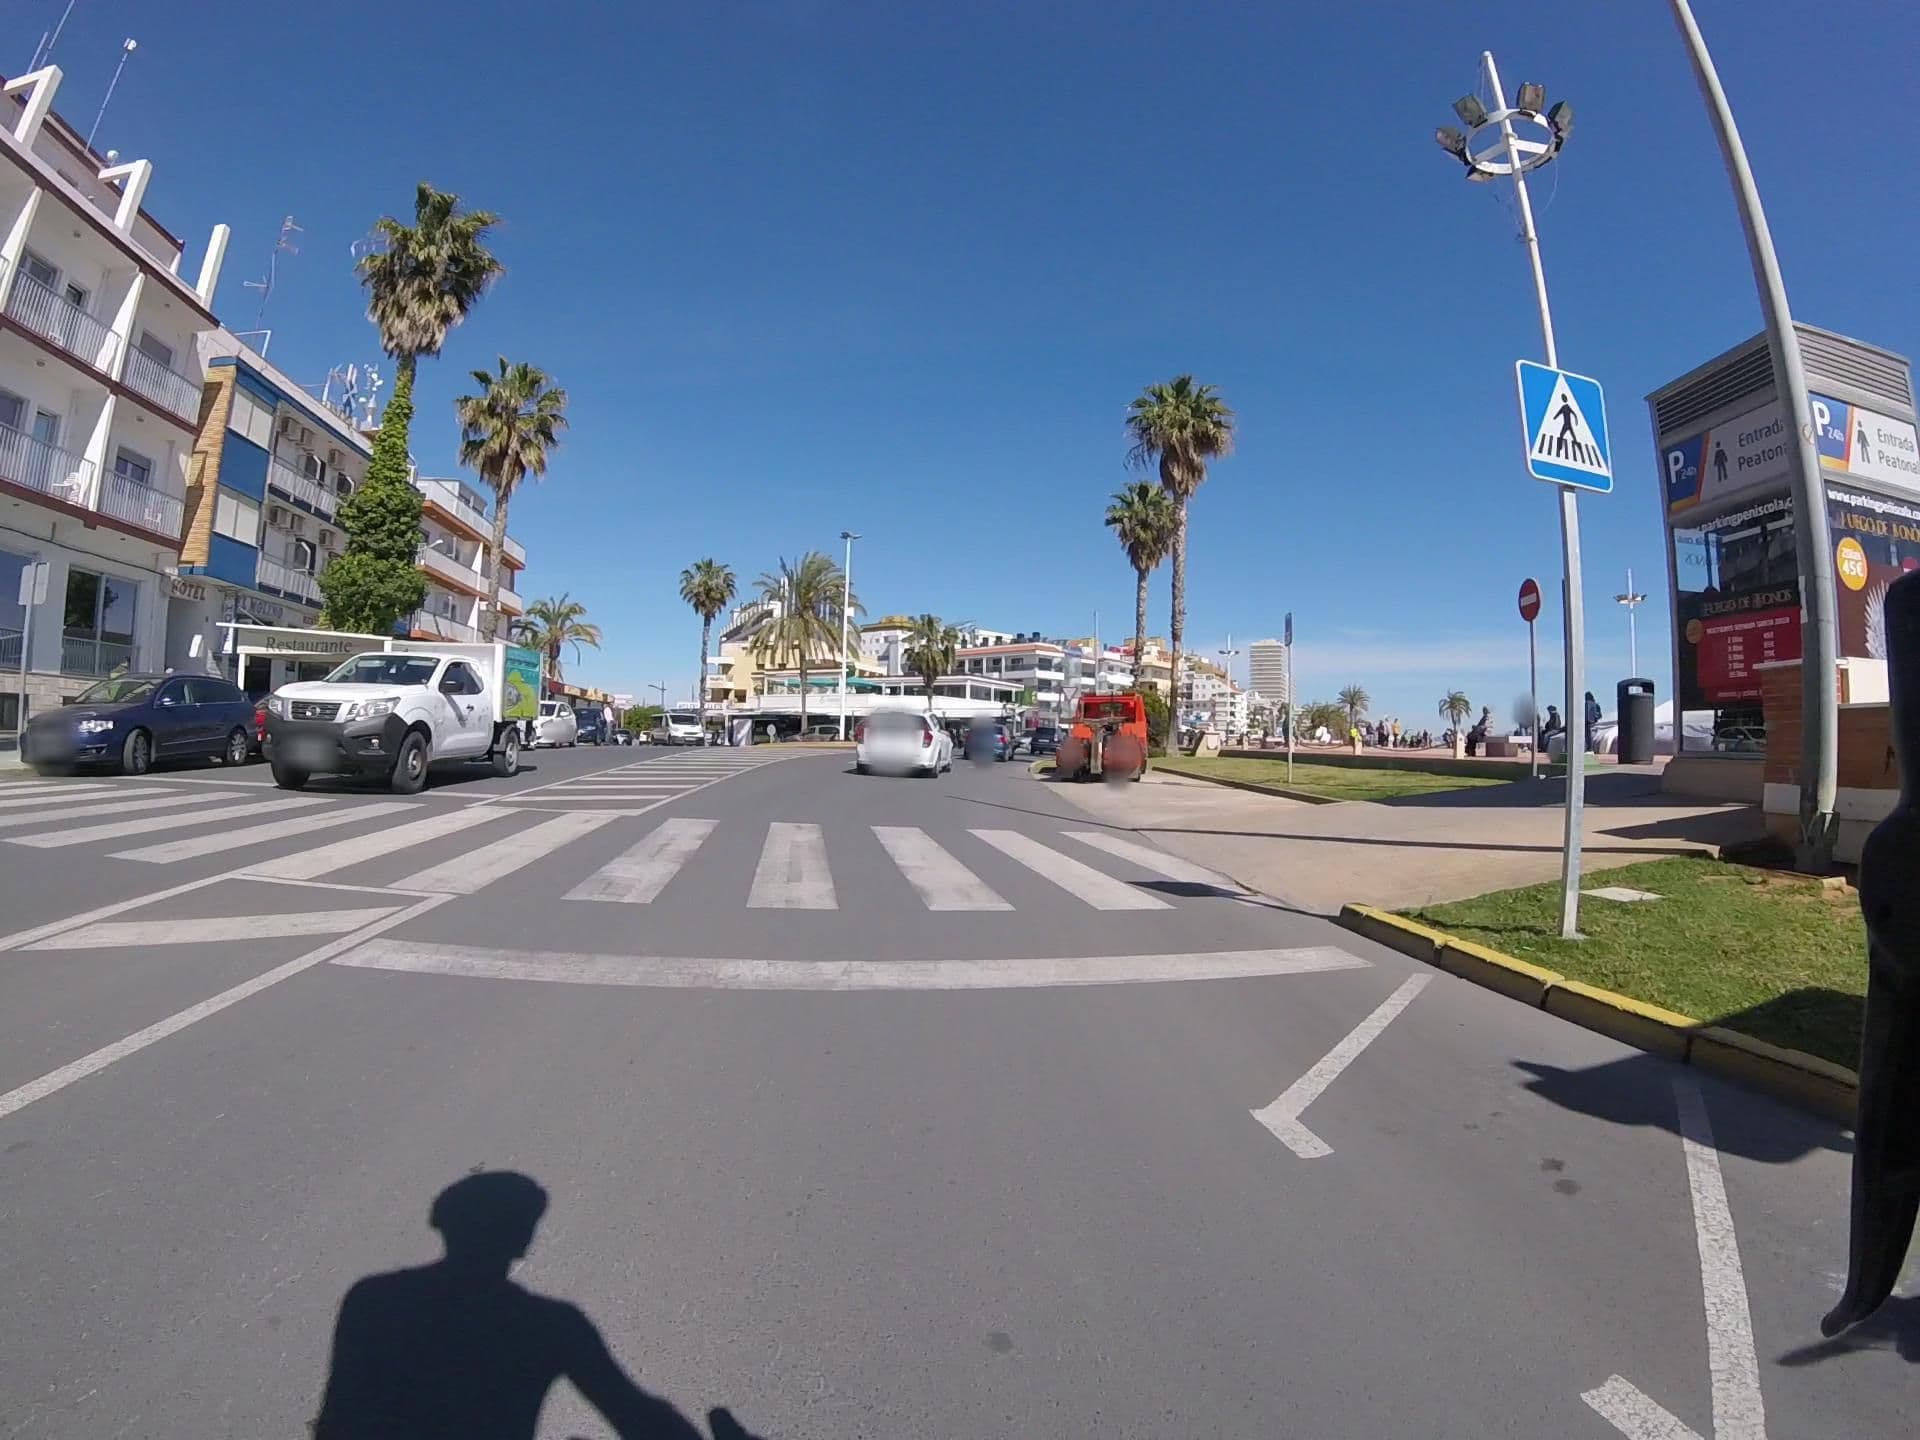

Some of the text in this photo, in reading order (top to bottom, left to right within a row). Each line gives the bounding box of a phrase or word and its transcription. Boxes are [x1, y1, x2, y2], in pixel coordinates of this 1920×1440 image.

[1812, 401, 1831, 436] P
[1877, 428, 1915, 453] Entrada
[1668, 450, 1684, 484] P
[171, 579, 206, 601] HOTEL
[266, 636, 353, 653] Restaurante
